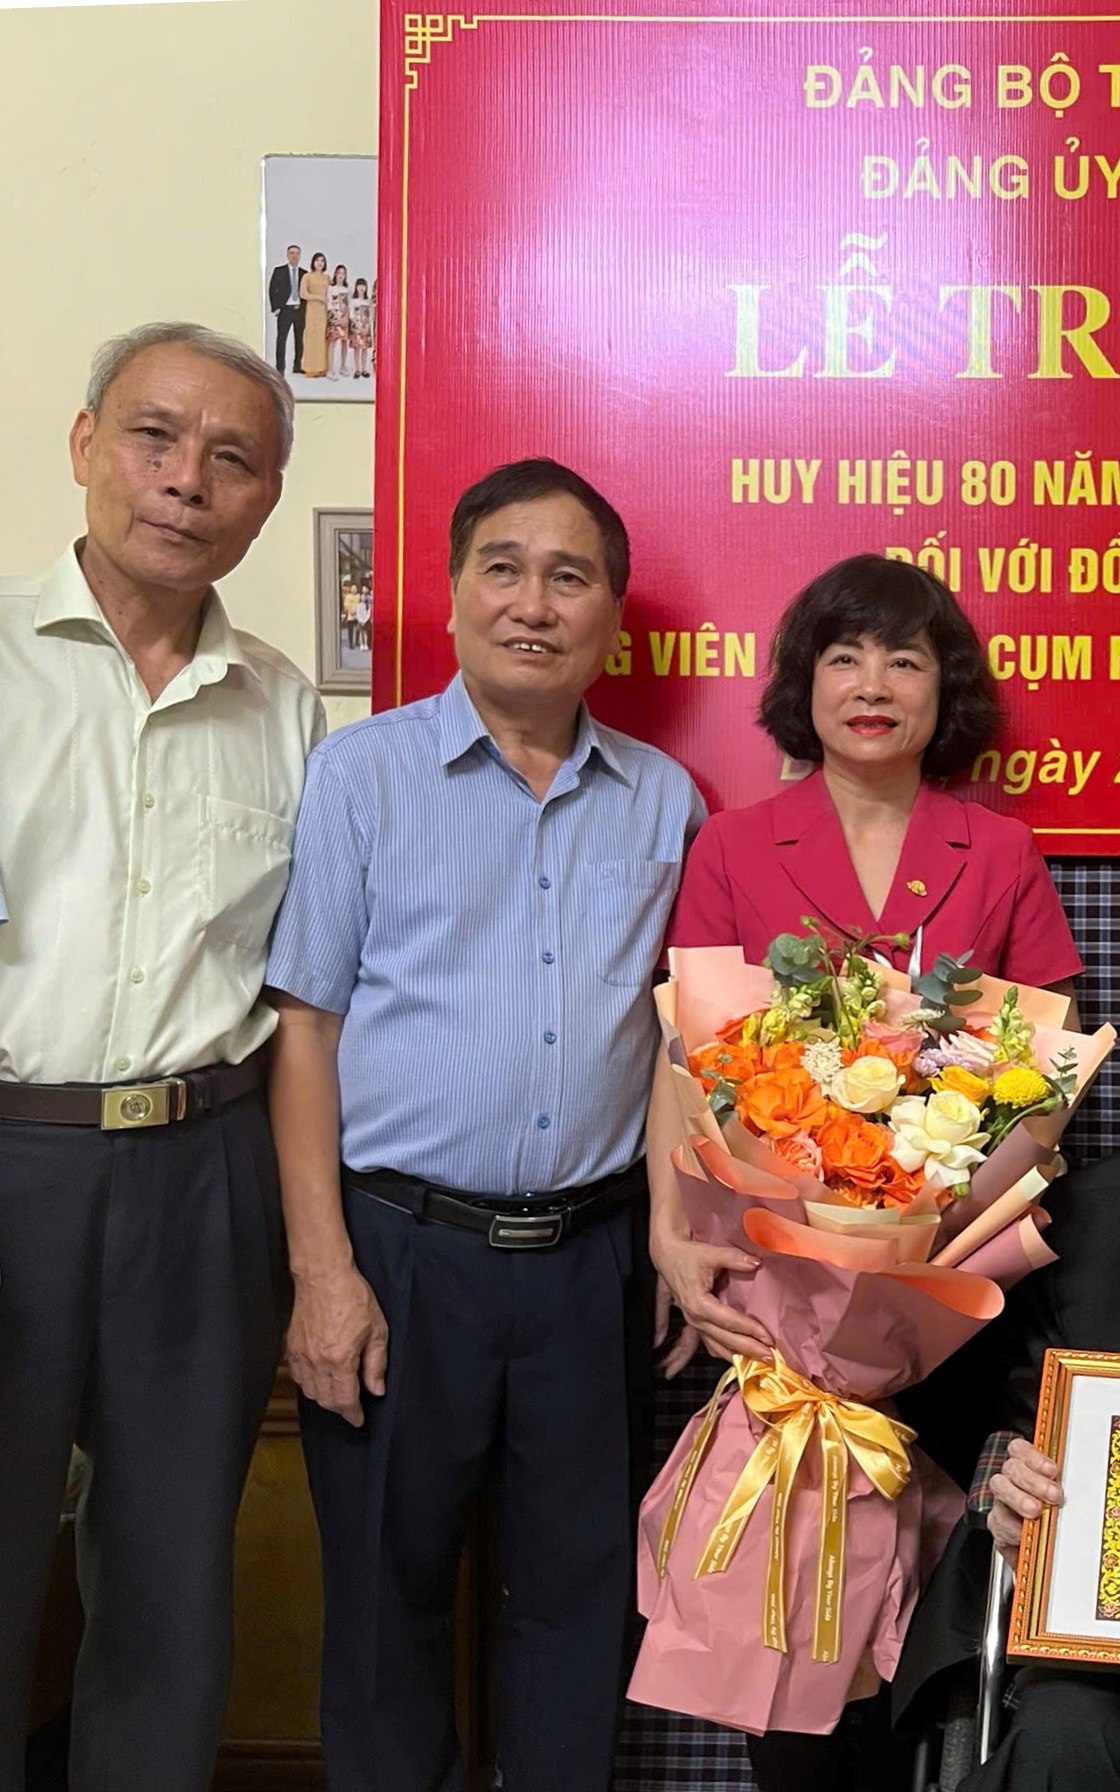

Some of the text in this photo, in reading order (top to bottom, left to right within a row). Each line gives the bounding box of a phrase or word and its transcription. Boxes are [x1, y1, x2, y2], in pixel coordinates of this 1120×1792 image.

[803, 47, 971, 108] ĐẢNG
[998, 52, 1080, 118] BỘ
[861, 137, 1029, 200] ĐẢNG
[724, 232, 897, 380] LỄ
[731, 458, 816, 505] HUY
[837, 450, 944, 516] HIỆU
[961, 461, 1016, 506] 80
[978, 538, 1052, 593] VỚI
[649, 622, 756, 677] VIÊN
[988, 635, 1092, 690] CỤM
[970, 739, 1101, 795] ngày
